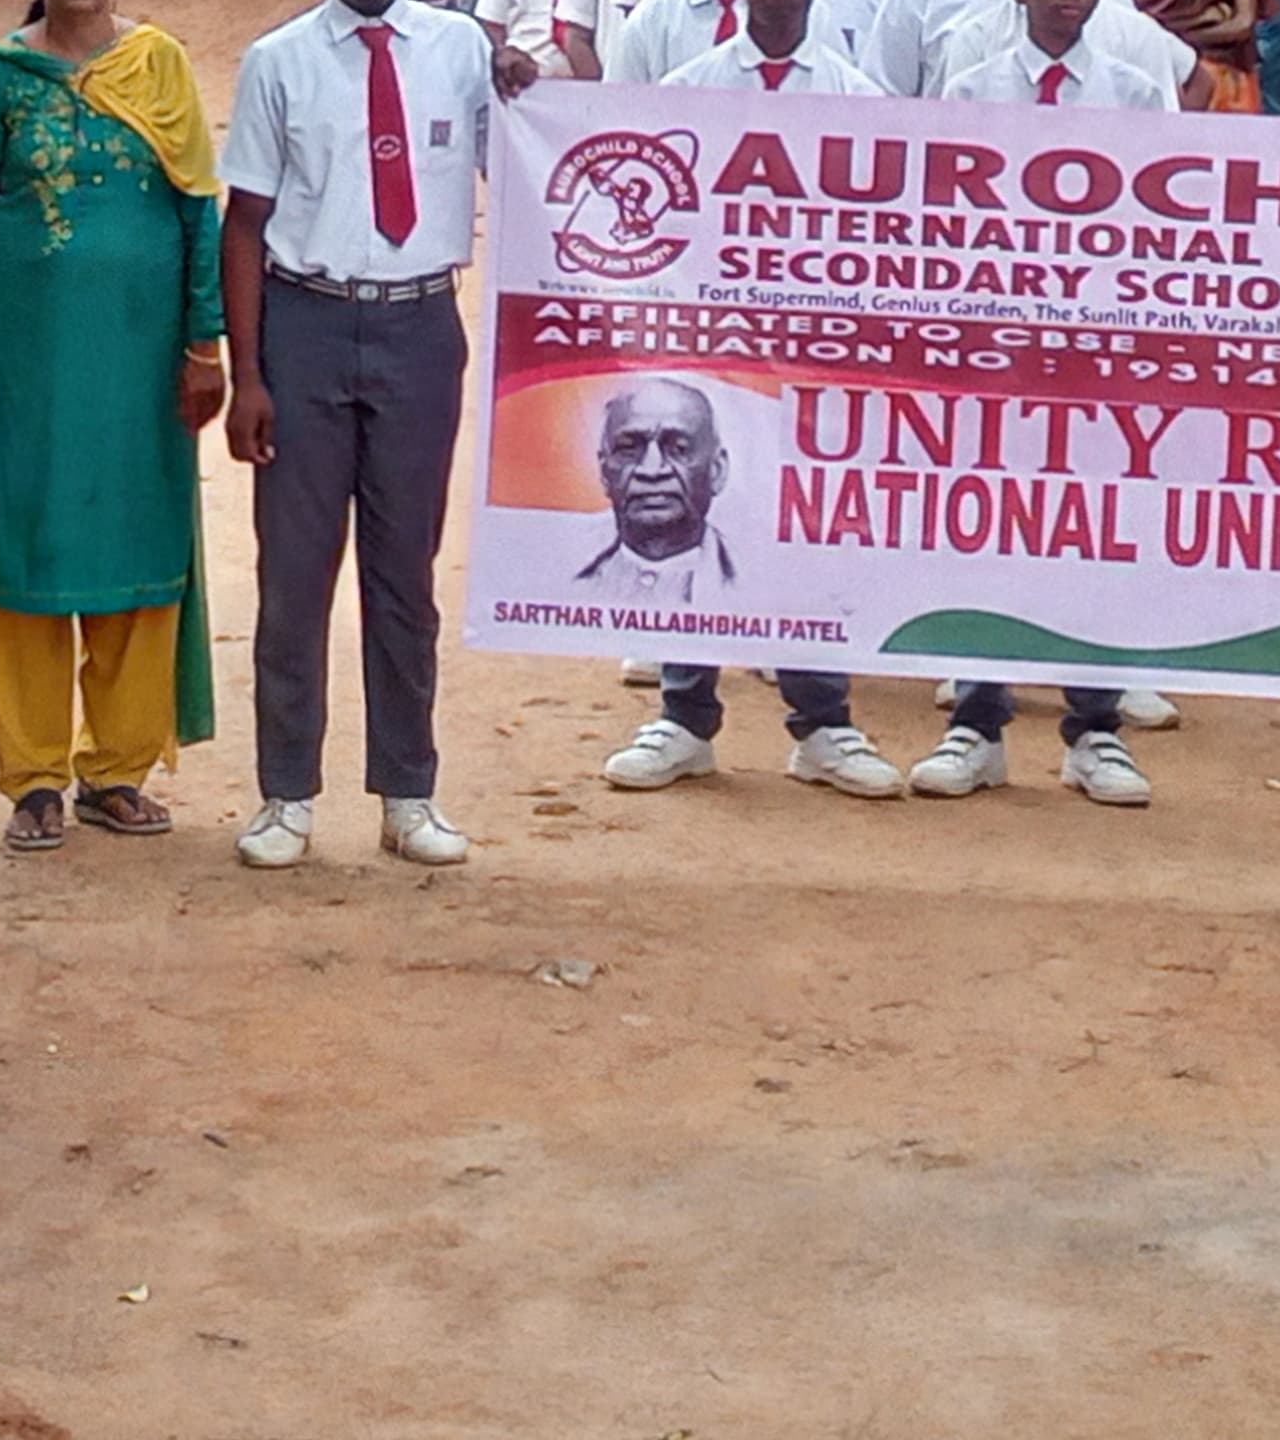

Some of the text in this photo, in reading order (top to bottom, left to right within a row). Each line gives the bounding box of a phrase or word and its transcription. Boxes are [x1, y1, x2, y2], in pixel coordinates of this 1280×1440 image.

[554, 138, 692, 206] AUROCHILD SCHOOL
[723, 203, 1262, 265] INTERNATIONAL
[719, 246, 1093, 299] SECONDARY
[535, 300, 858, 335] AFFILIATED
[887, 322, 961, 341] TO
[990, 330, 1135, 353] CBSE
[698, 284, 740, 304] Fort
[747, 288, 865, 311] Supermind,
[872, 296, 940, 315] Genius
[948, 299, 1027, 321] Garden,
[1035, 305, 1072, 321] The
[1079, 307, 1139, 326] Sunlit
[1145, 311, 1198, 333] Path,
[534, 324, 892, 363] AFFILIATION
[925, 347, 1011, 368] NO
[791, 385, 1184, 480] UNITY
[777, 465, 1137, 563] NATIONAL
[494, 601, 848, 643] SARTHAR VALLABHBHAI PATEL
